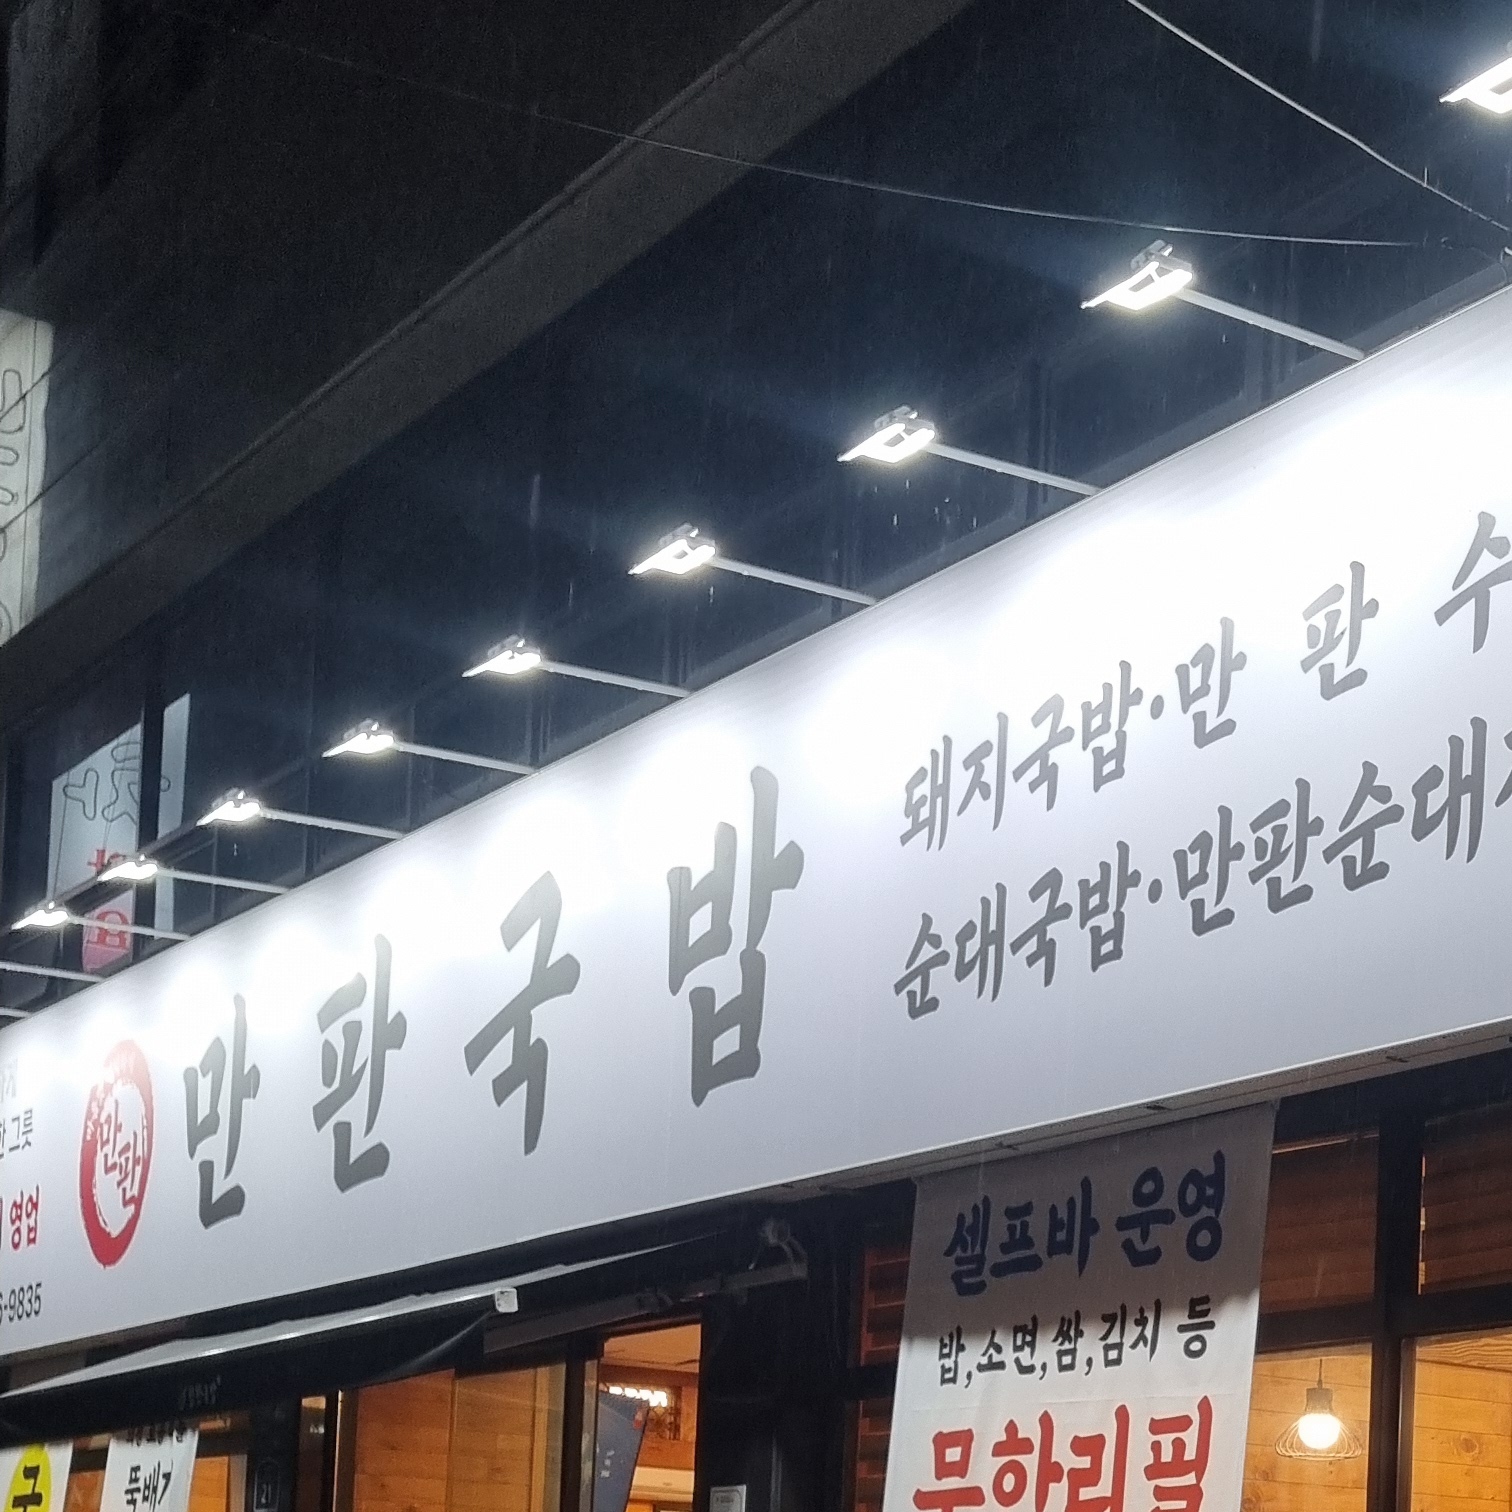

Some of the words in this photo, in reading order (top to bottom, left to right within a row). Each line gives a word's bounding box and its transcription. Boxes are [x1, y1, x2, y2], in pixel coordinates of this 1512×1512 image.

[9, 1184, 40, 1251] 영업
[942, 1175, 1100, 1296] 셀프바
[1115, 1149, 1227, 1268] 운영
[1176, 1294, 1216, 1359] 등
